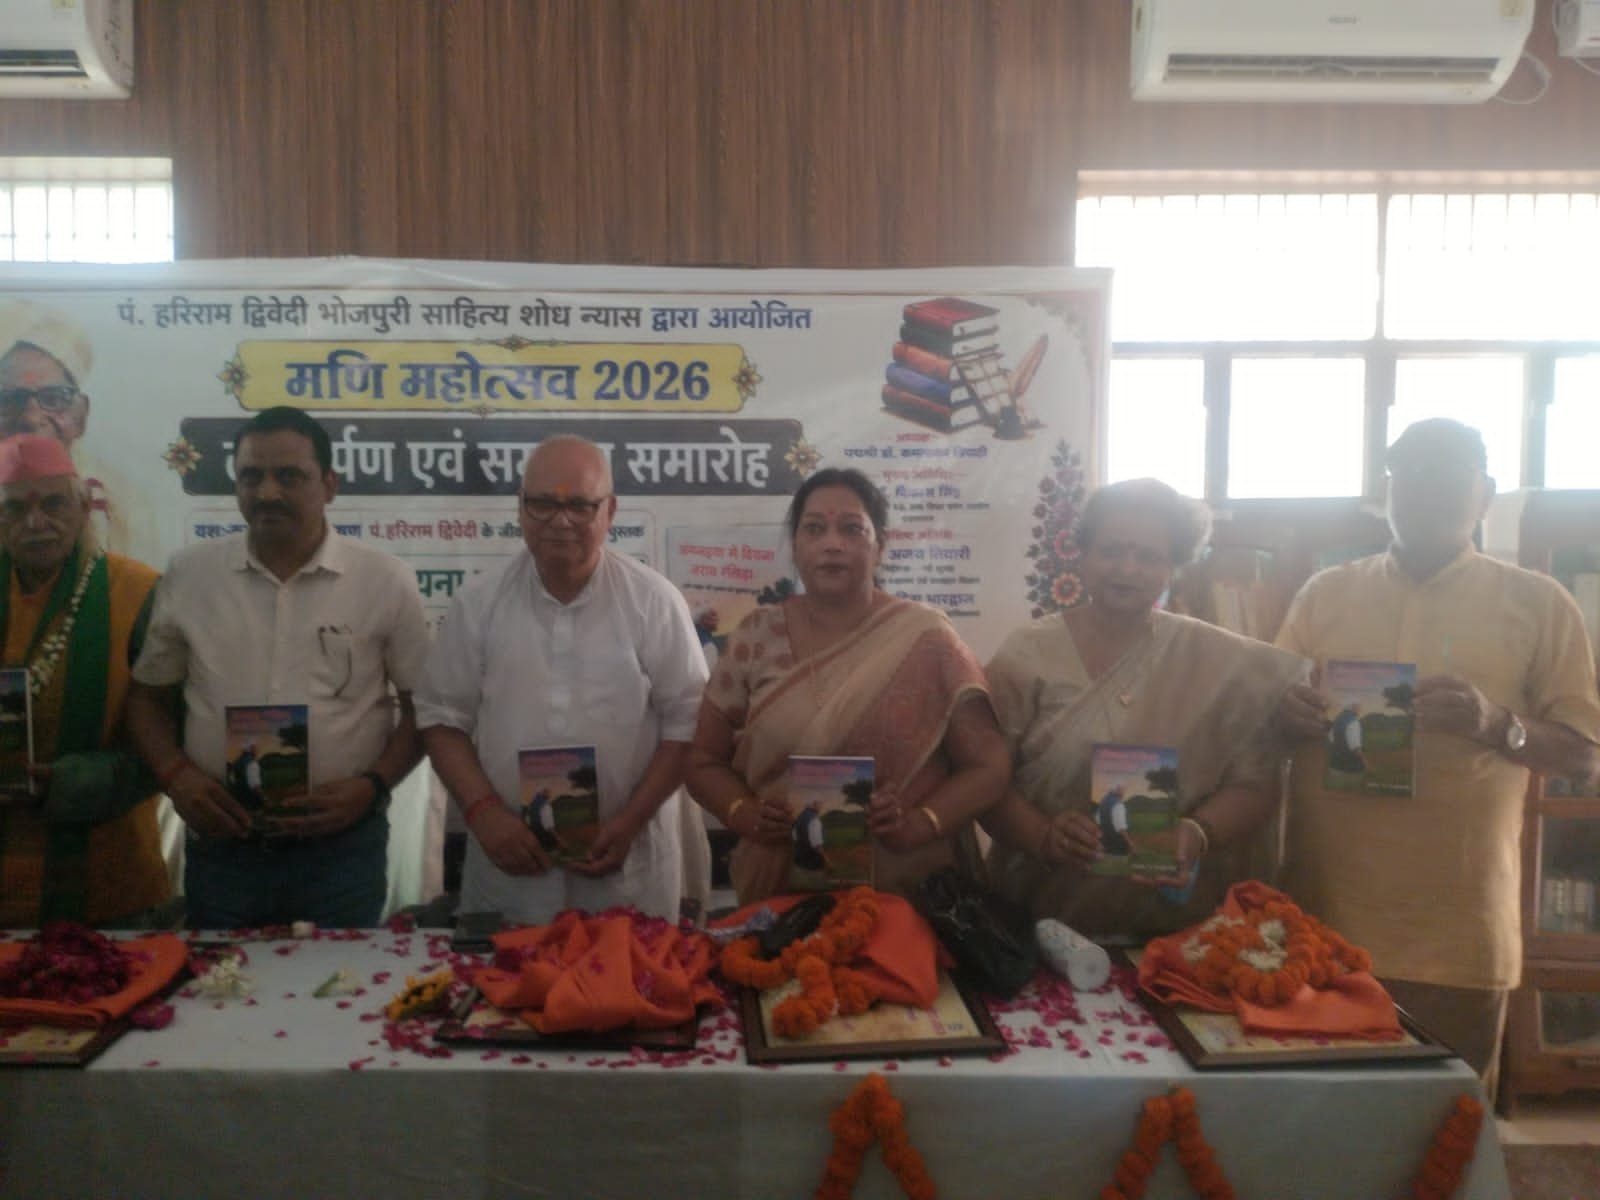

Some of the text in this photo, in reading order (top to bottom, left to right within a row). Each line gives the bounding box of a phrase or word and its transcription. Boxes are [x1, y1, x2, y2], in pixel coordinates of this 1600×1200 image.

[119, 296, 812, 332] पं. हरिराम द्विवेदी भोजपुरी साहित्य शोध न्यास द्वारा आयोजित
[285, 348, 711, 402] मणि महोत्सव 2026
[407, 430, 467, 488] एवं
[624, 427, 772, 488] समारोह
